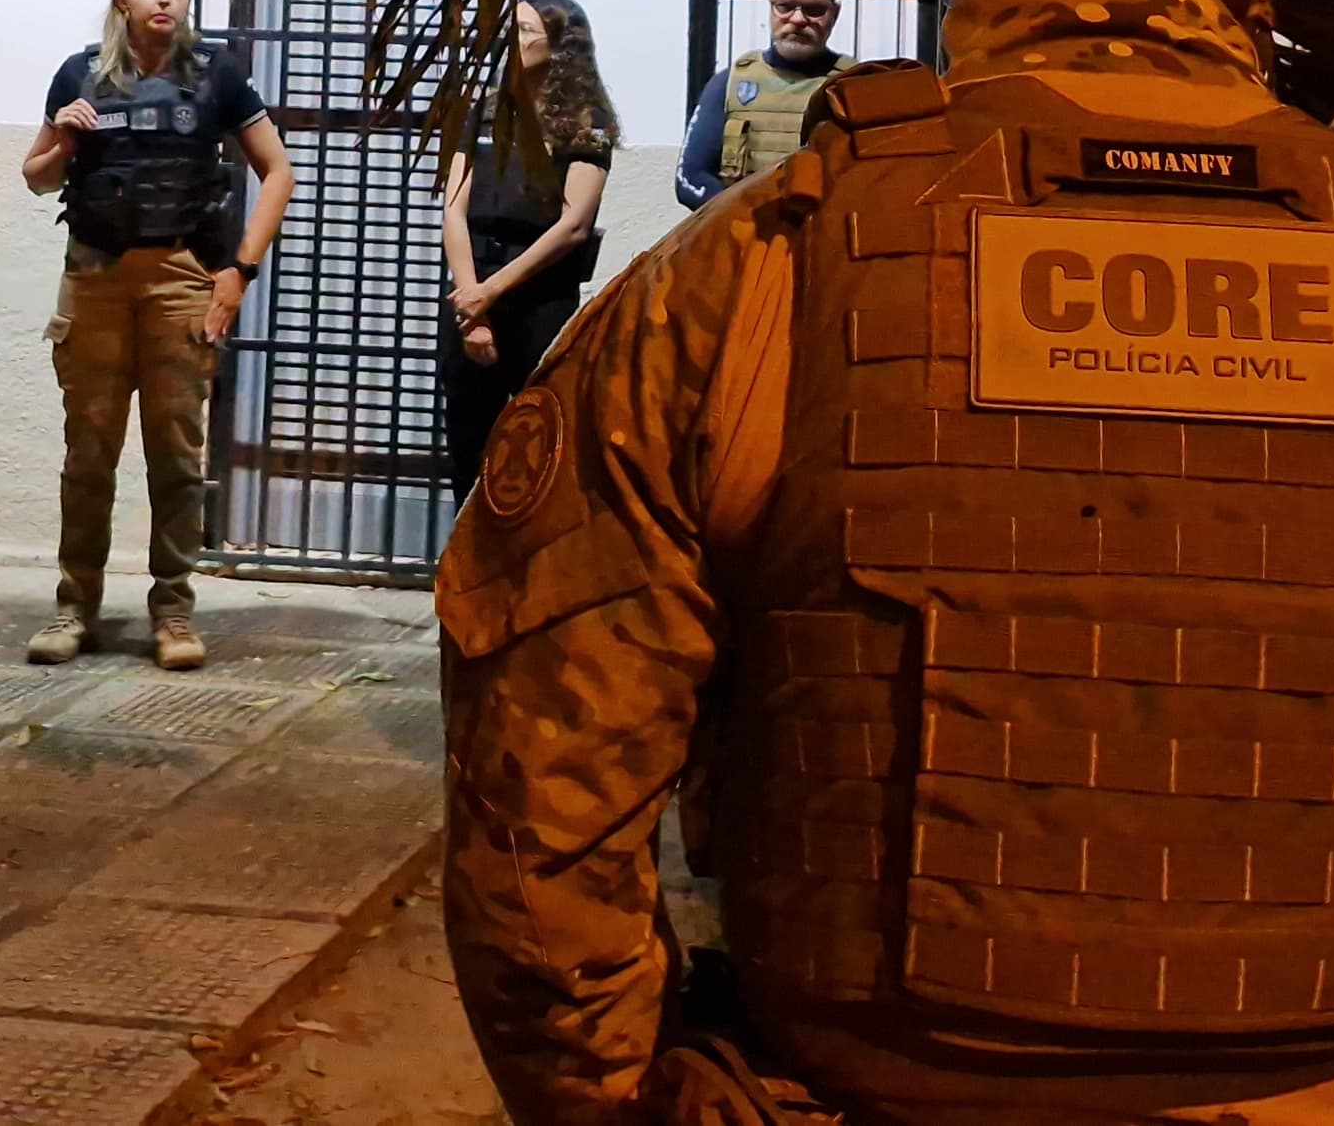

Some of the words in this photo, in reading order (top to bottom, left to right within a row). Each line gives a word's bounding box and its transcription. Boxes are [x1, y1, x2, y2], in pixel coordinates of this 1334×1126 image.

[1021, 249, 1334, 343] CORE
[1049, 343, 1200, 376] POLÍCIA
[1213, 356, 1307, 381] CIVIL
